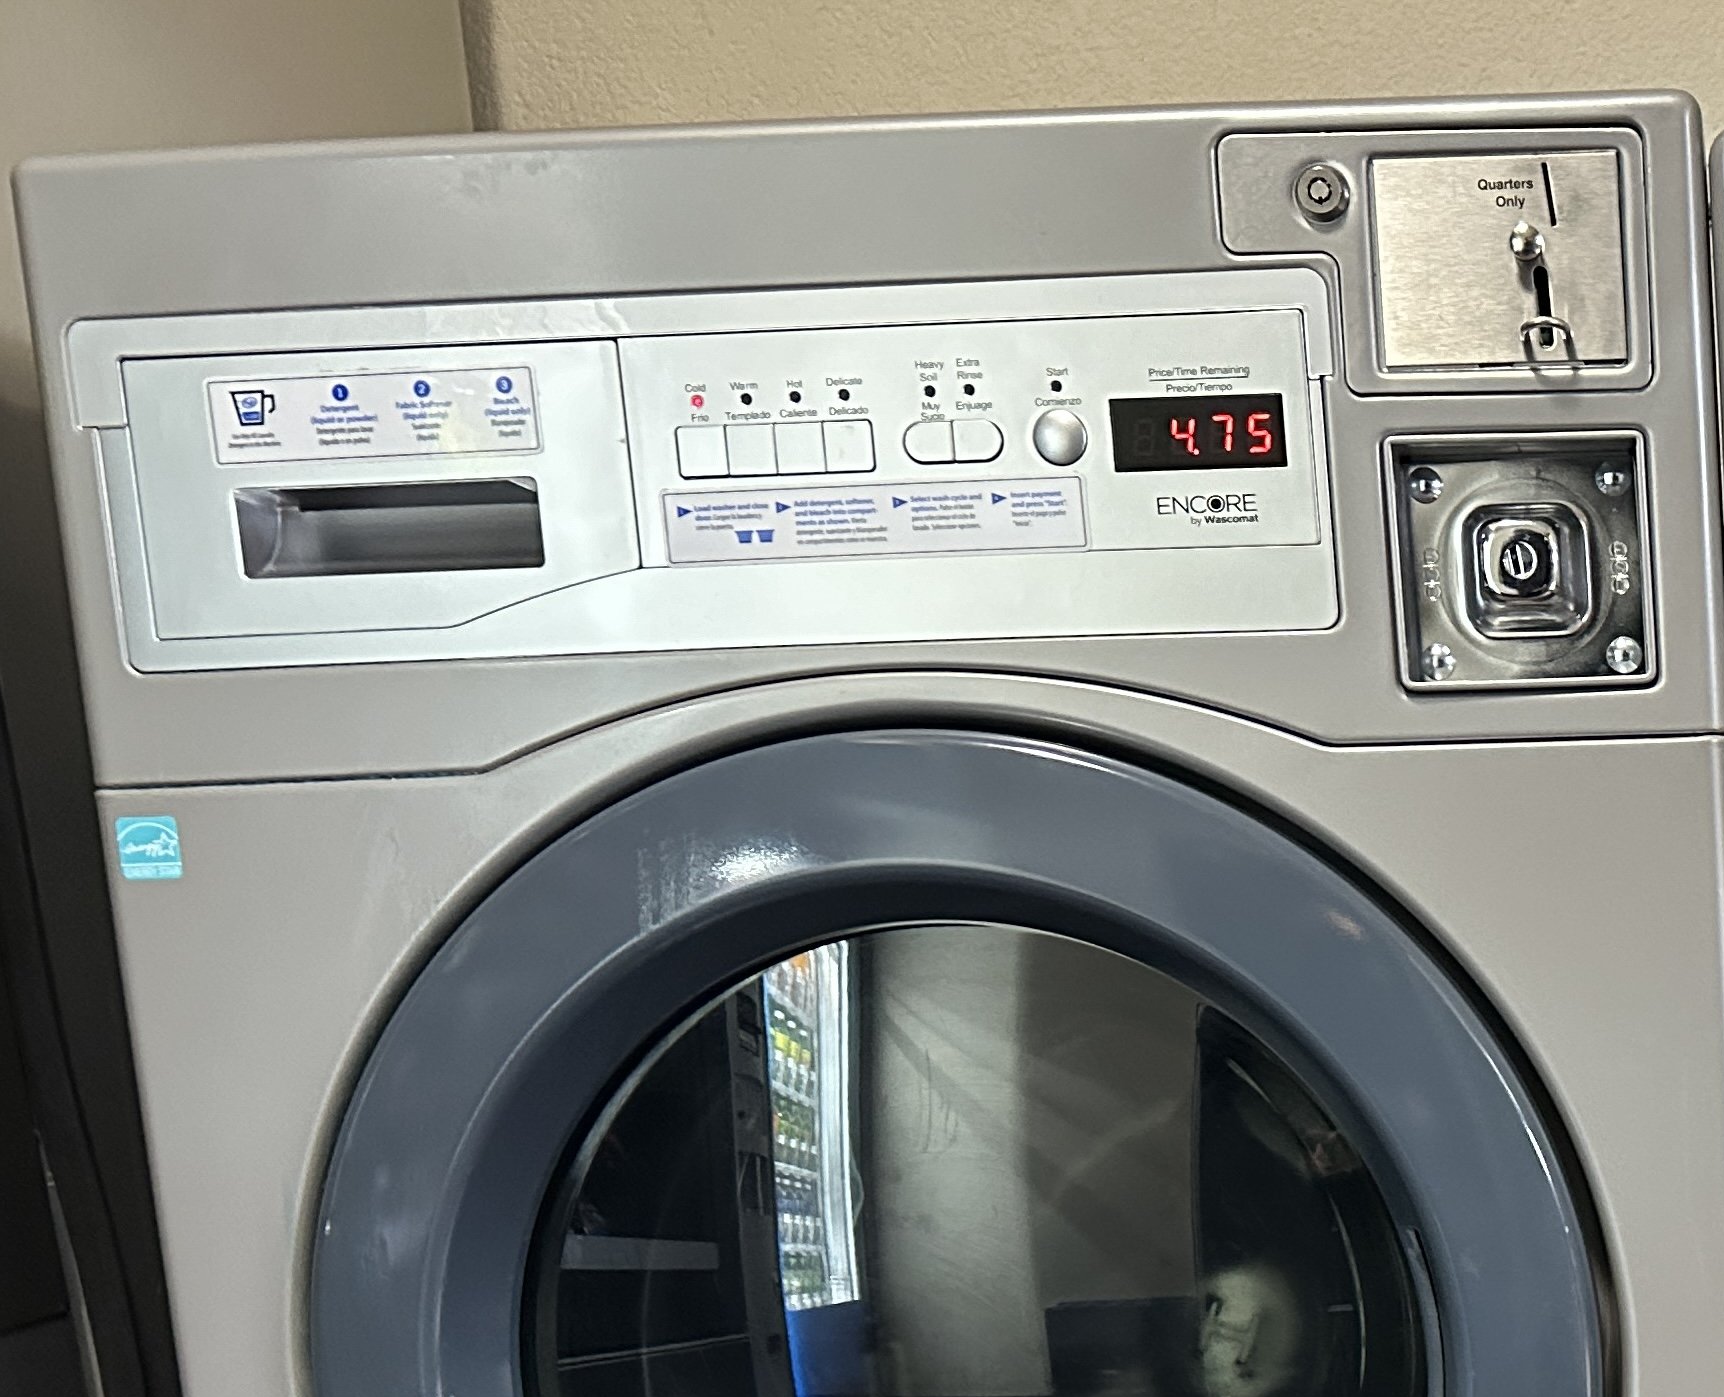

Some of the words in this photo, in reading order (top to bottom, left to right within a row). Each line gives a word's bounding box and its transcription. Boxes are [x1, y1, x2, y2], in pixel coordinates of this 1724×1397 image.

[1477, 178, 1534, 192] Quarters
[1495, 195, 1526, 210] Only
[914, 360, 944, 371] Heavy
[955, 358, 980, 368] Extra
[957, 371, 984, 380] Rinse
[1045, 367, 1069, 376] Start
[1148, 367, 1198, 377] Price/Time
[1200, 366, 1250, 377] Remaining
[825, 377, 863, 387] Delicate
[919, 372, 938, 382] Soil
[684, 383, 706, 393] Cold
[729, 381, 759, 391] Warm
[786, 379, 803, 389] Hot
[1165, 382, 1233, 393] Precio/Tiempo
[921, 402, 940, 412] Muy
[955, 401, 993, 411] Enjuage
[1034, 397, 1082, 407] Comienzo
[320, 404, 360, 413] Detergent
[779, 408, 818, 418] Caliente
[828, 406, 869, 416] Delicado
[725, 411, 772, 421] Templado
[1171, 413, 1272, 455] 4.75
[1156, 494, 1258, 515] ENCORE
[1190, 517, 1202, 527] by
[1204, 514, 1259, 524] Wascomat
